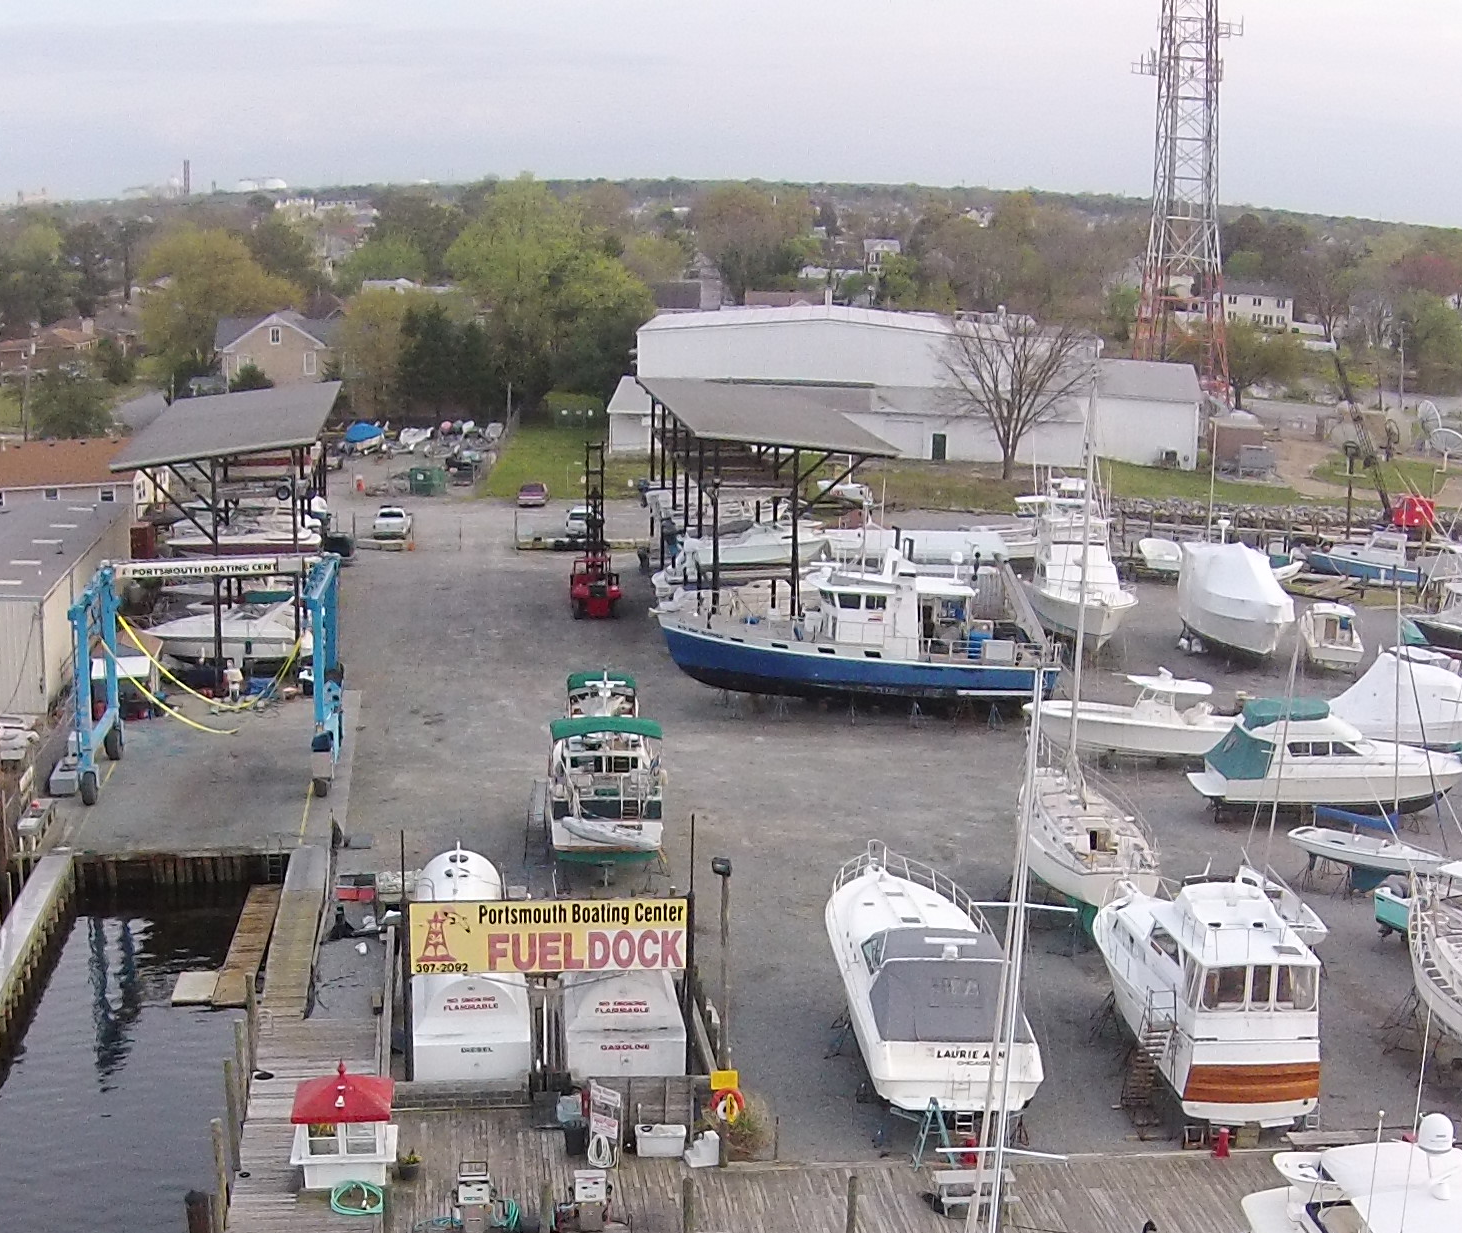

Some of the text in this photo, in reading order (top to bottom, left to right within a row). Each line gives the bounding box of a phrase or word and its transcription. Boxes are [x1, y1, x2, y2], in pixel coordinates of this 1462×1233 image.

[132, 567, 202, 576] PORTSMOUTH
[204, 565, 249, 574] BOATING
[478, 903, 684, 925] Portsmouth Boating Center
[487, 929, 684, 970] FUEL DOCK
[416, 963, 468, 973] 397-2092
[600, 1043, 650, 1051] GASOLINE
[936, 1050, 979, 1059] LAURIE
